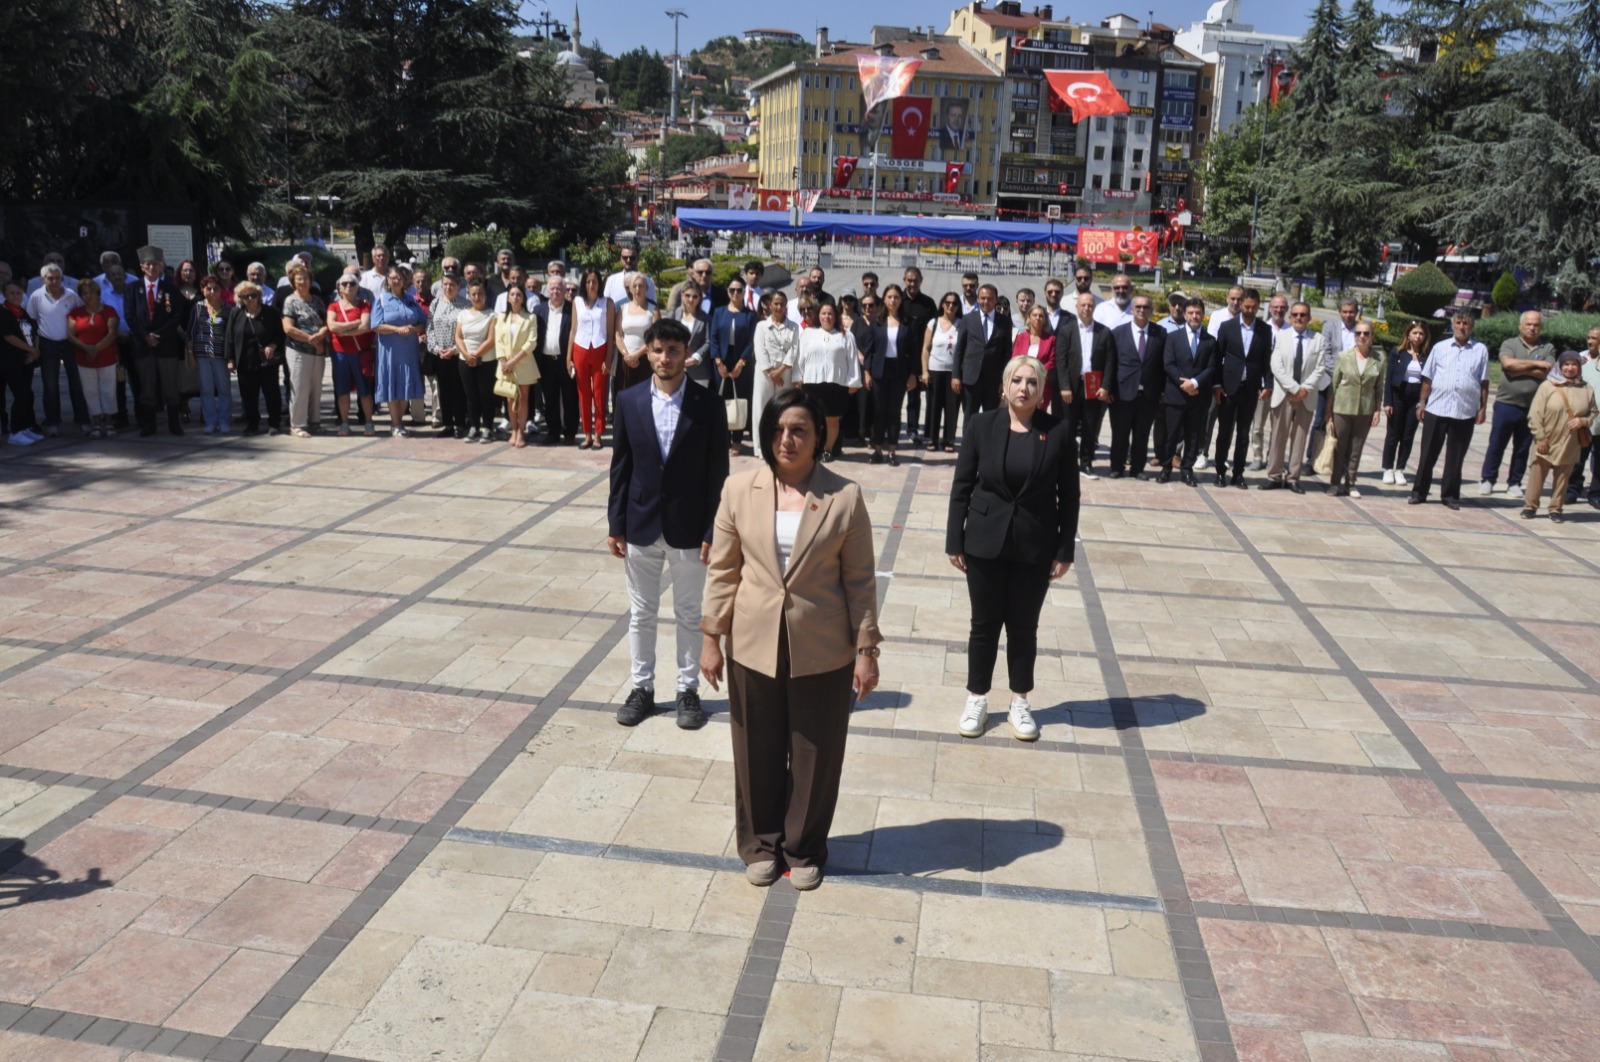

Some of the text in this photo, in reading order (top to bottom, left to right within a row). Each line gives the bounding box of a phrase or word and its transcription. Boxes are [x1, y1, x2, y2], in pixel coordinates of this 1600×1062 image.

[1032, 40, 1084, 53] Bilge Group
[884, 159, 924, 168] OSGEB
